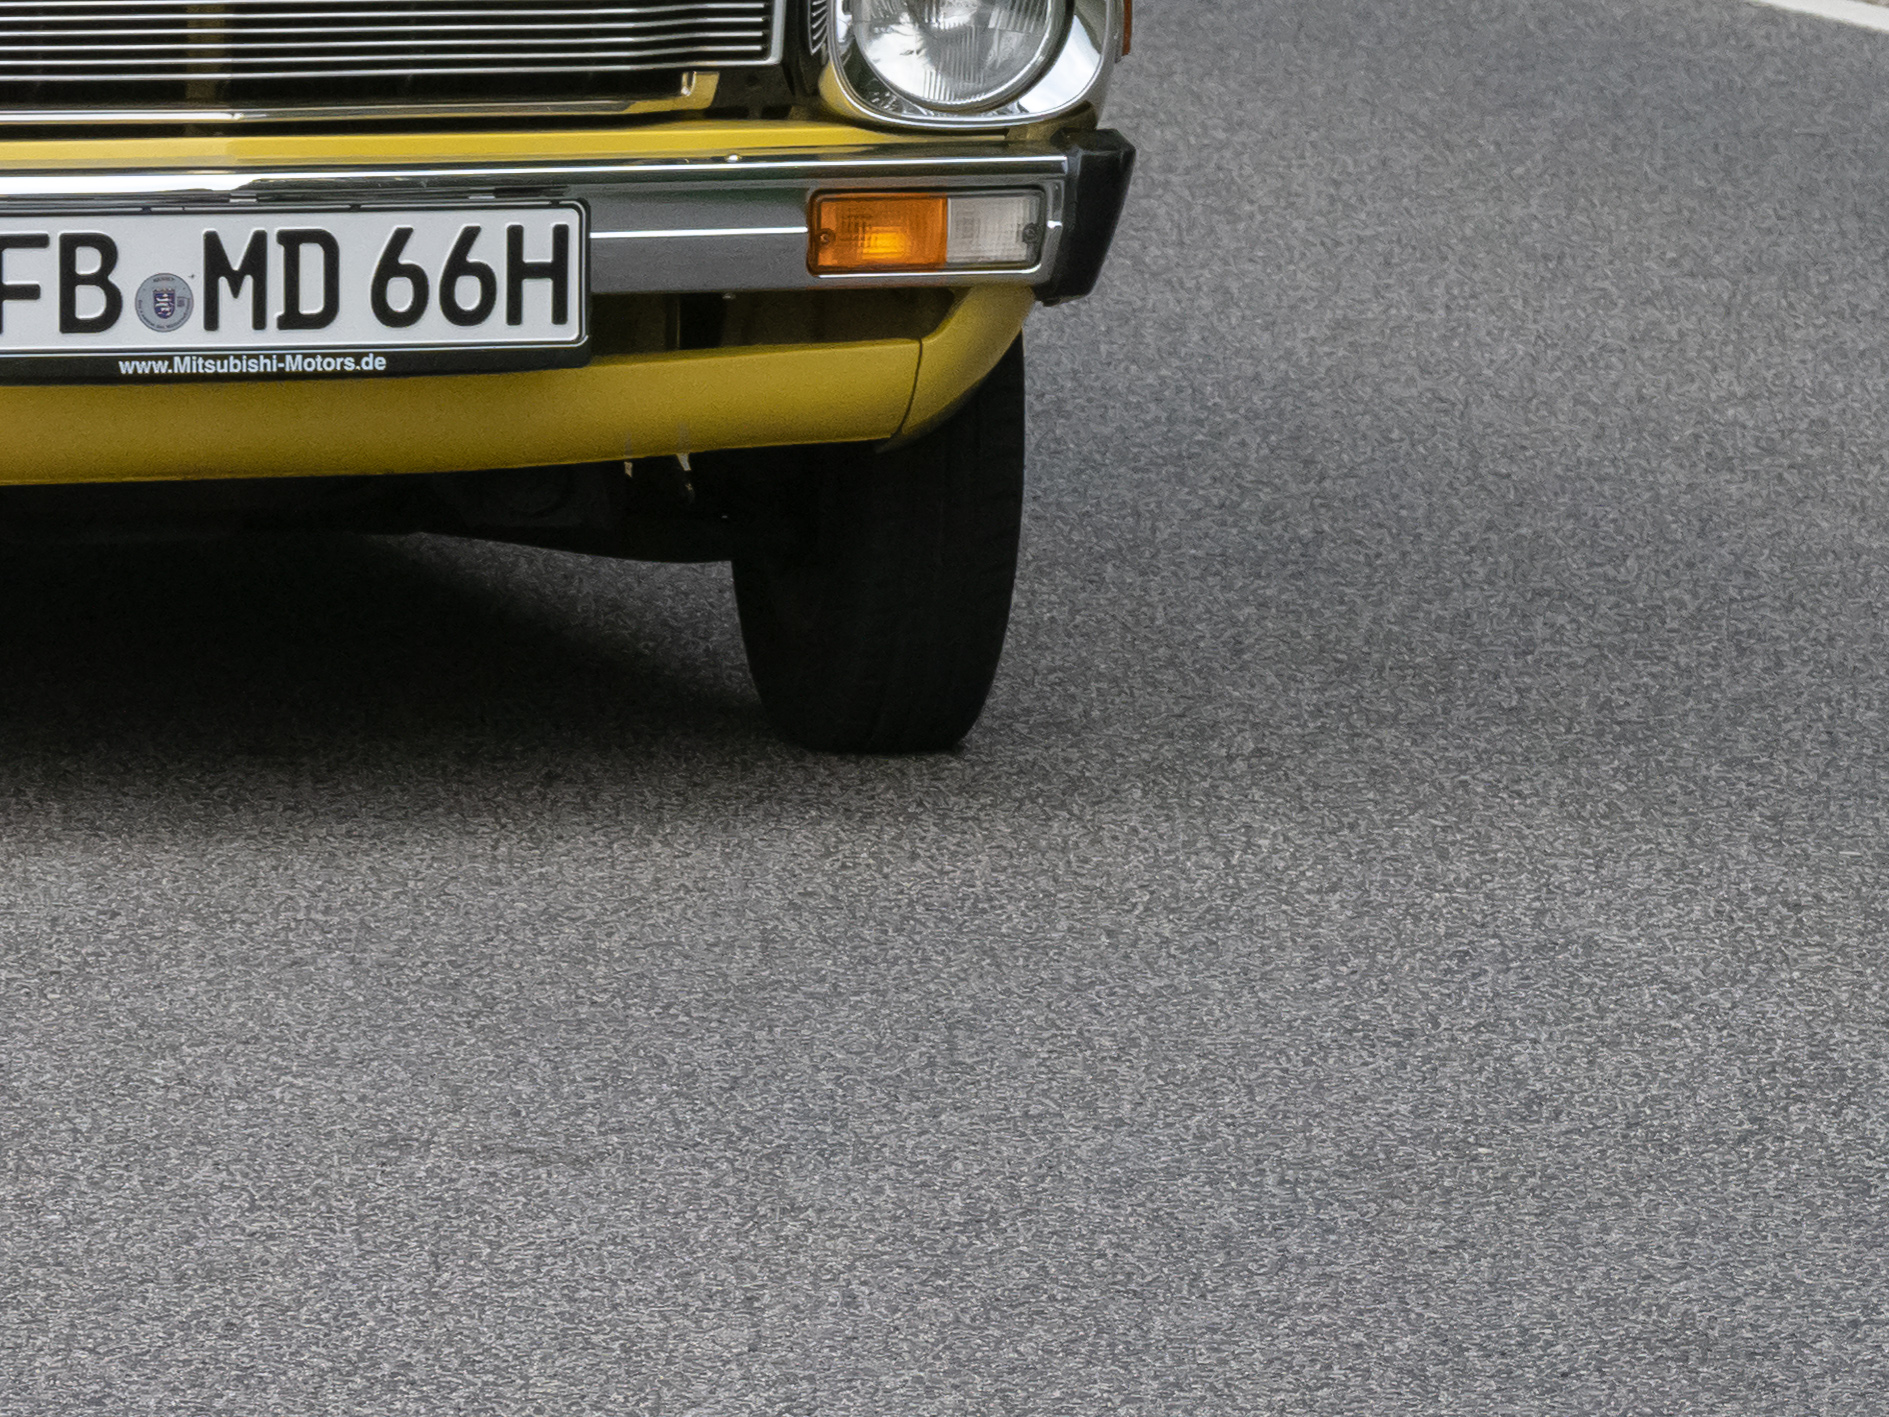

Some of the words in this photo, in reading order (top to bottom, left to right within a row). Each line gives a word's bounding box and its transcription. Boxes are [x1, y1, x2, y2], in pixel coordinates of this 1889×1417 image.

[202, 227, 342, 332] MD
[370, 223, 571, 328] 66H
[117, 354, 388, 376] www.Mitsubishi-Motors.de
